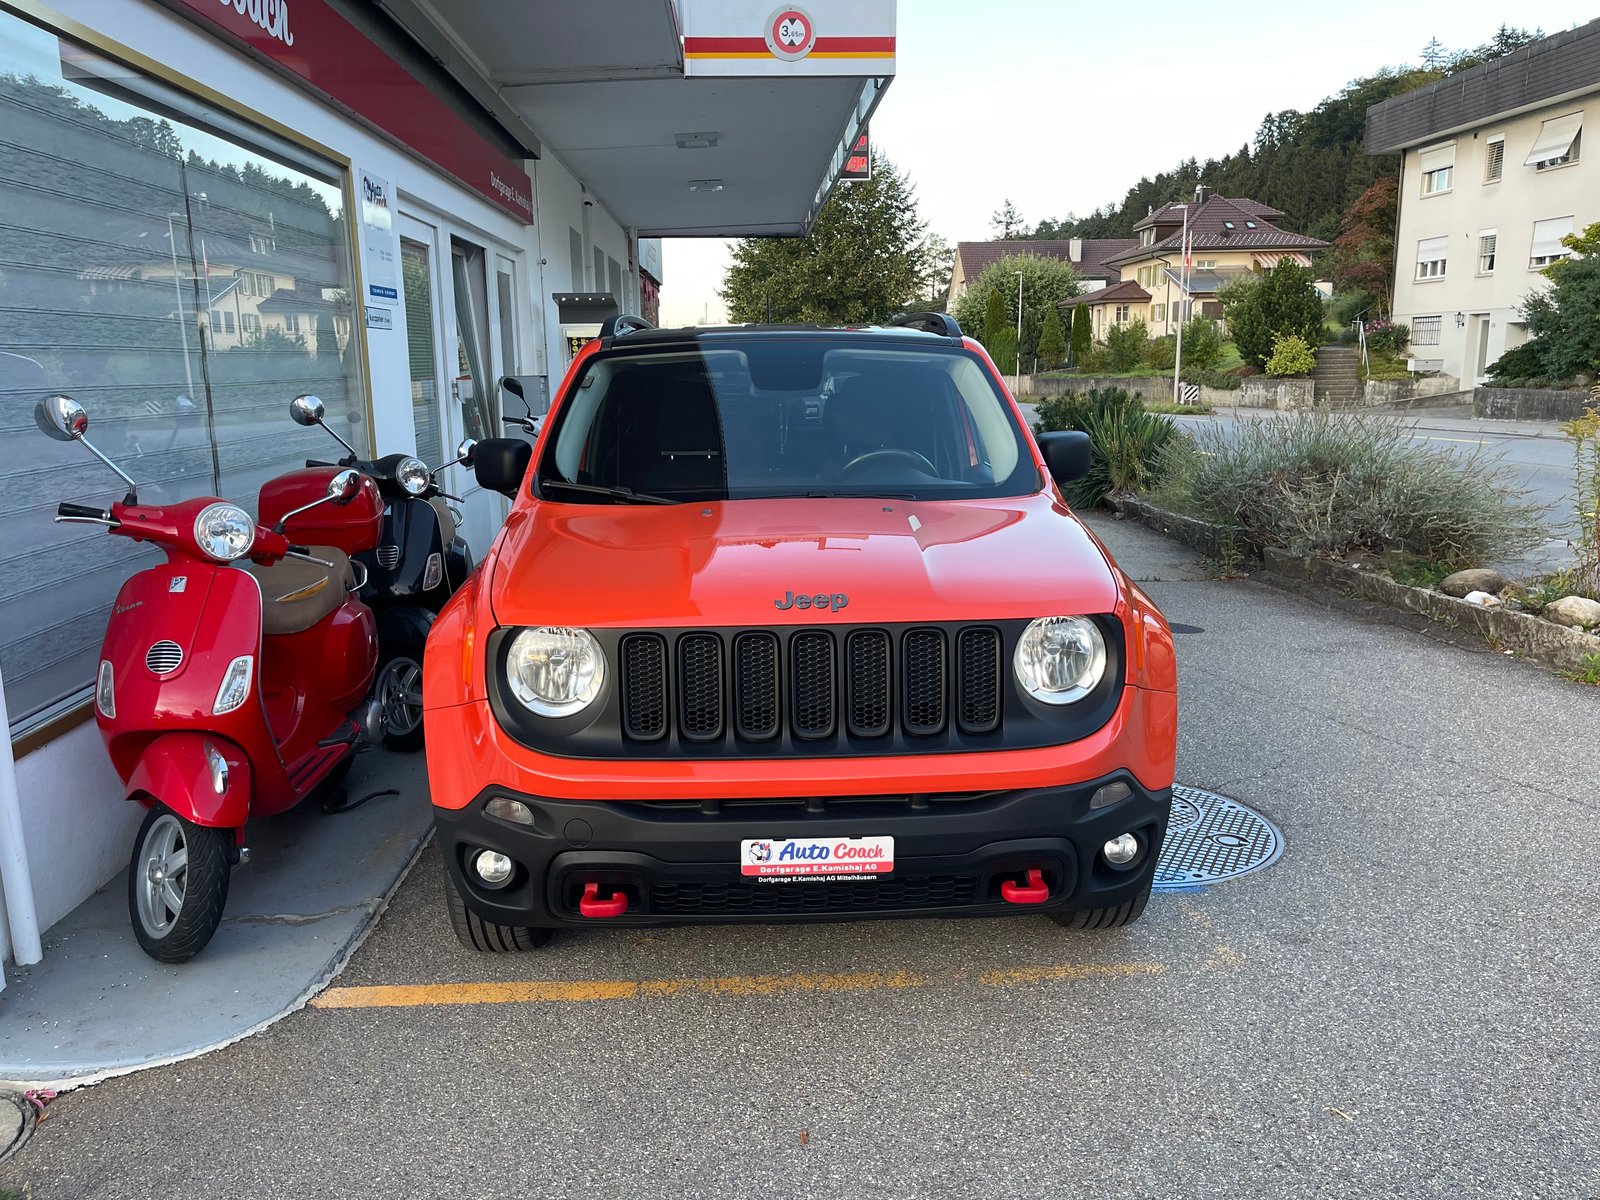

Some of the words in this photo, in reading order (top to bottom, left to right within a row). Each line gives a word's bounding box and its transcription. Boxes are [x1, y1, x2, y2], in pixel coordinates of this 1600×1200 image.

[774, 591, 849, 612] Jeep
[778, 842, 830, 861] Auto
[833, 843, 885, 859] Coach
[760, 866, 811, 875] Dorfgarage
[813, 864, 863, 872] E.Kamishaj
[864, 863, 877, 871] AG
[758, 876, 791, 884] Dorfgarage
